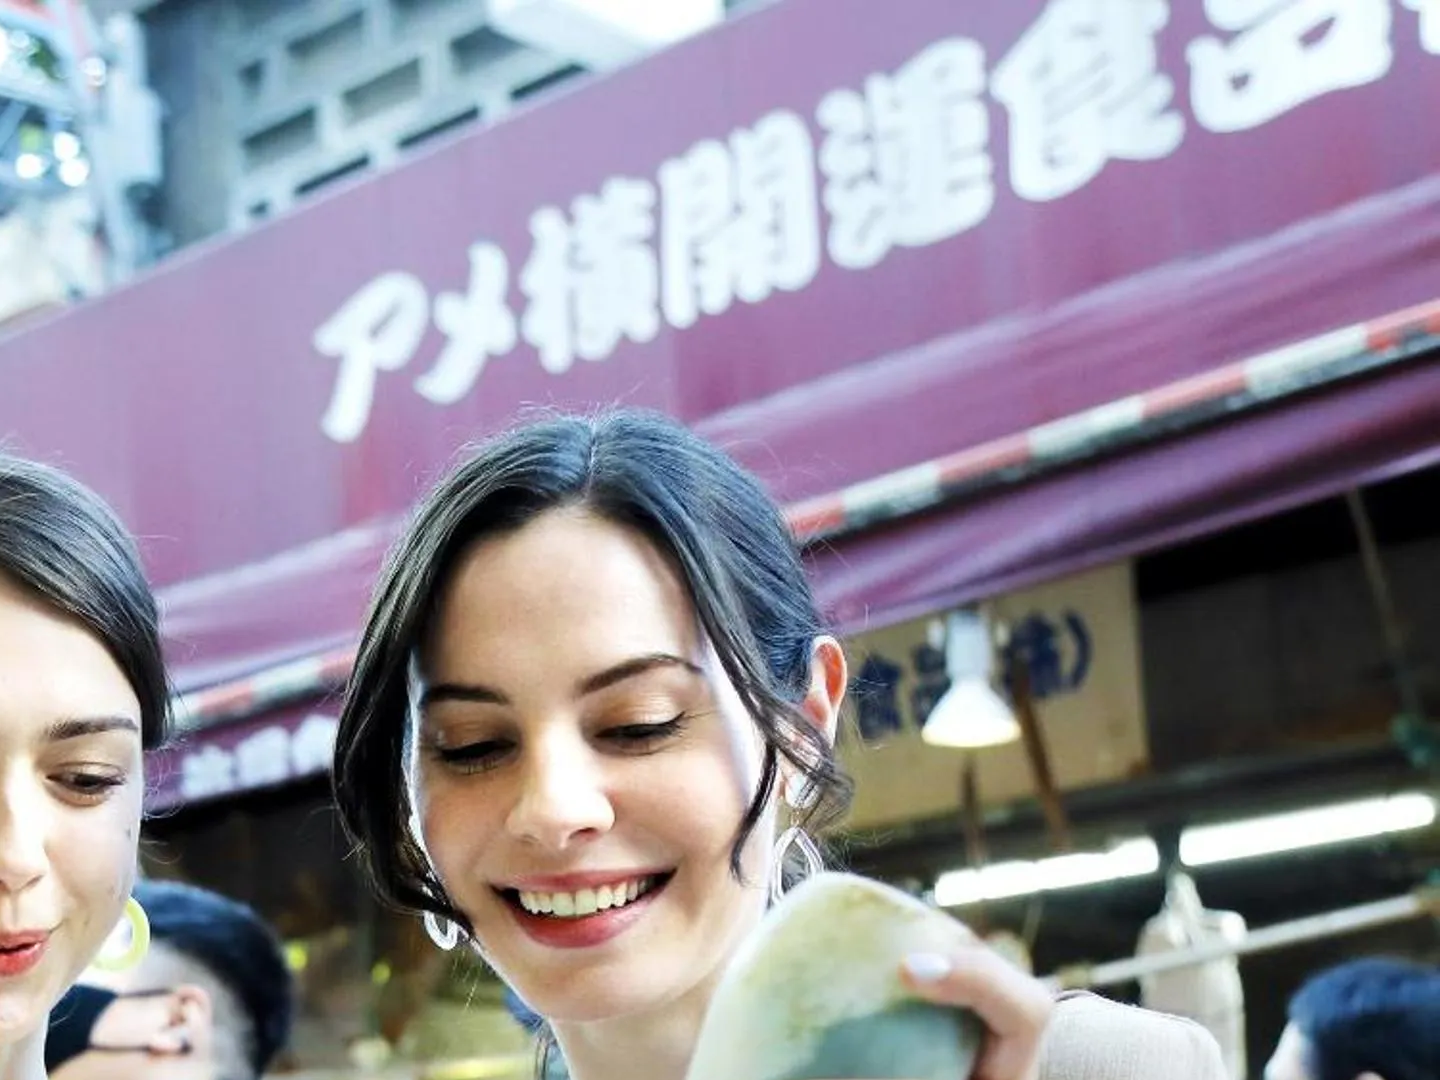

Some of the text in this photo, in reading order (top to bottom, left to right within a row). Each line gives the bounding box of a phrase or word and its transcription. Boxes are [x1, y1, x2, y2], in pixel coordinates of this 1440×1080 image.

[314, 0, 1440, 442] アメ横開運食品
